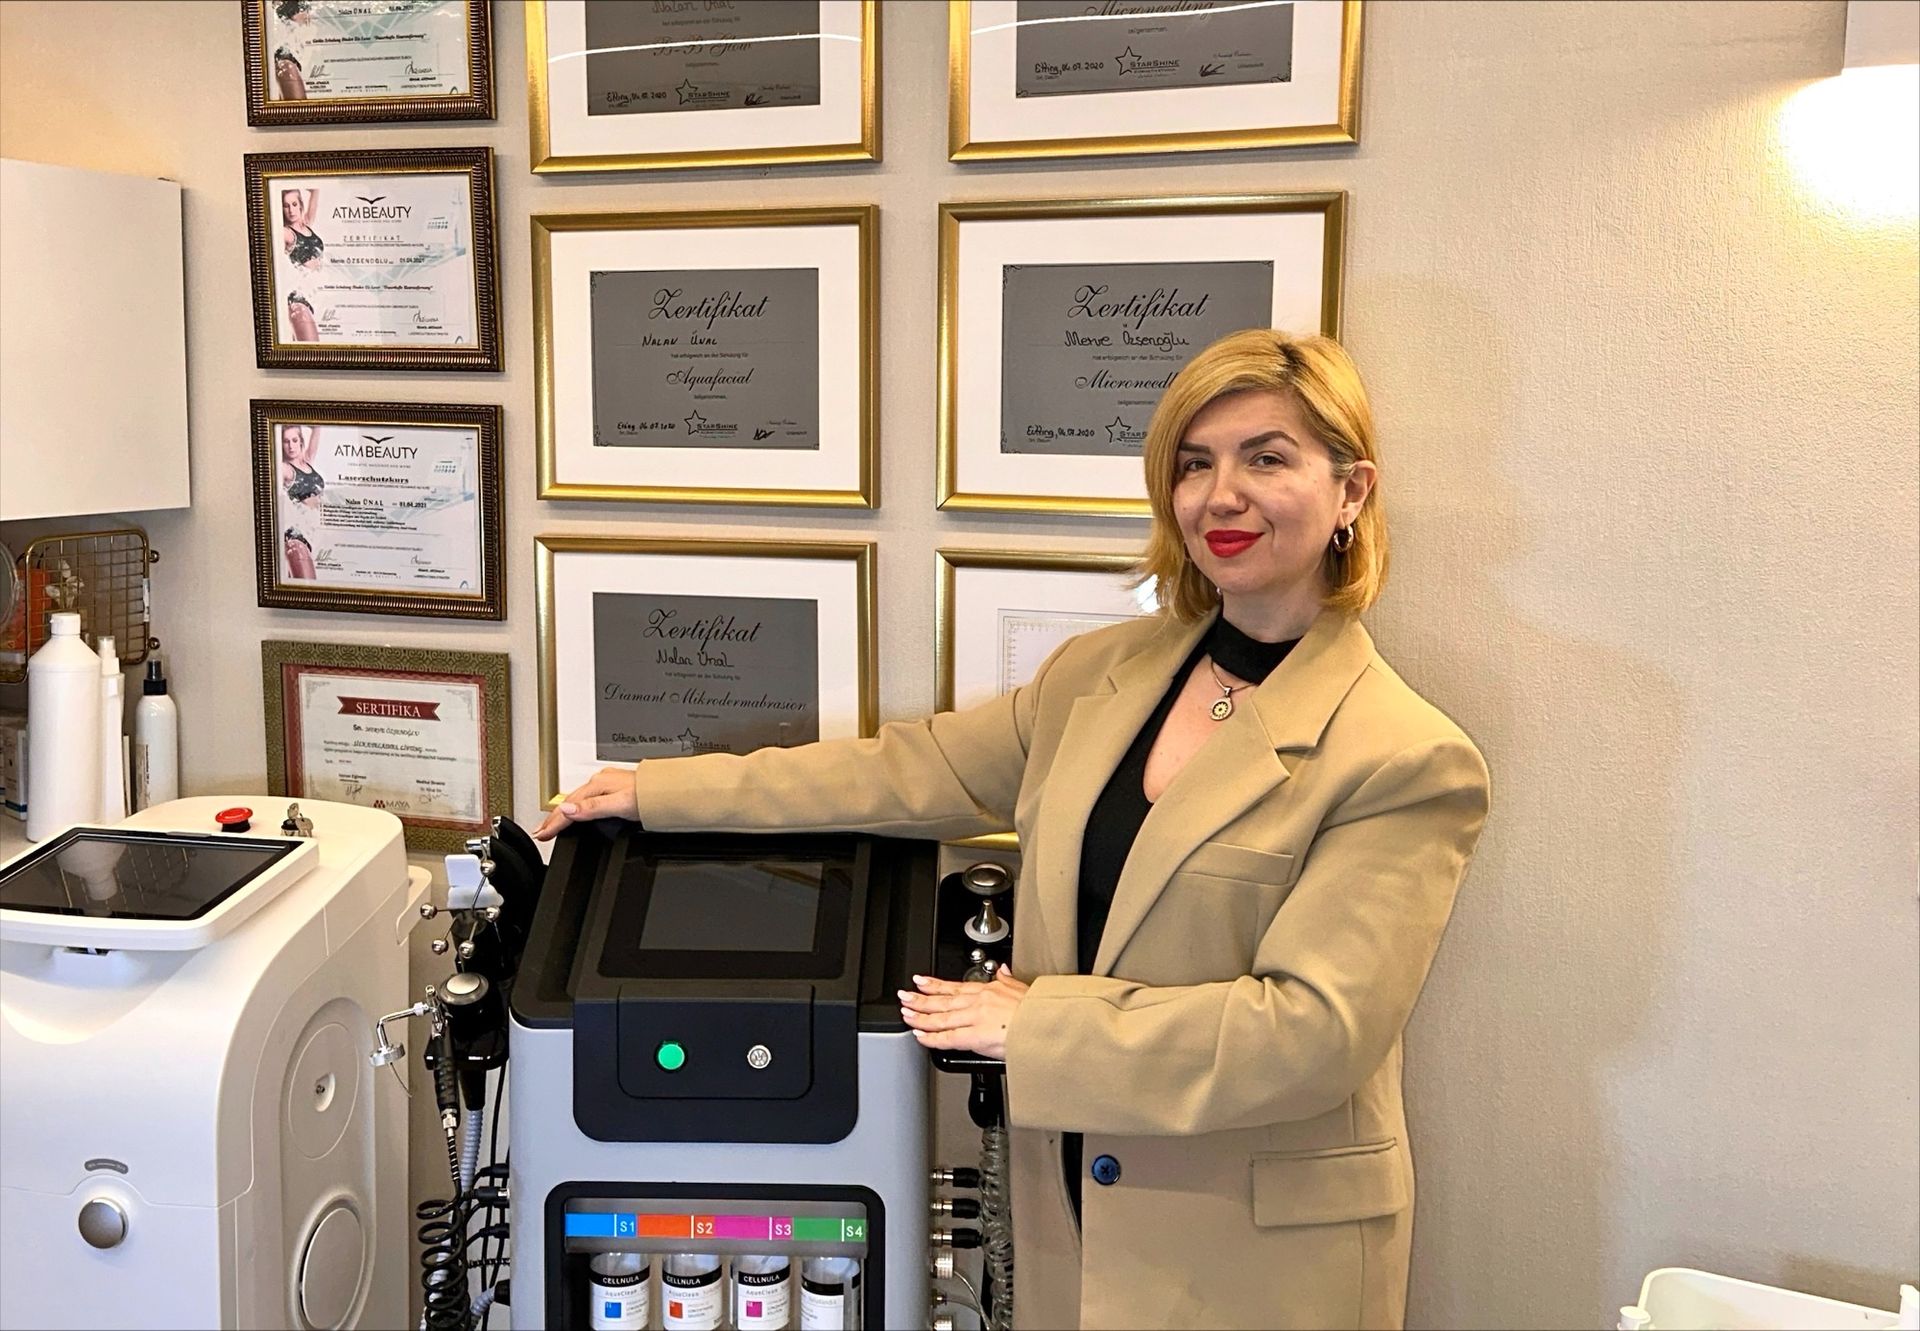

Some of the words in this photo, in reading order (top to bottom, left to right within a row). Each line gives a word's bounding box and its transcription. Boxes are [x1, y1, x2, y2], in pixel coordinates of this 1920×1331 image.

[648, 288, 770, 330] Zertifikat
[1067, 284, 1210, 330] Zertifikat
[666, 366, 755, 391] Aquafacial
[338, 474, 409, 484] Laserschutzkurs
[642, 608, 763, 651] Zertifikat
[620, 1222, 635, 1233] S1
[697, 1223, 713, 1235] S2
[775, 1225, 792, 1236] S3
[846, 1227, 863, 1238] S4
[602, 1275, 640, 1285] CELLNULA
[666, 1276, 701, 1286] CELLNULA
[743, 1274, 780, 1284] CELLNULA
